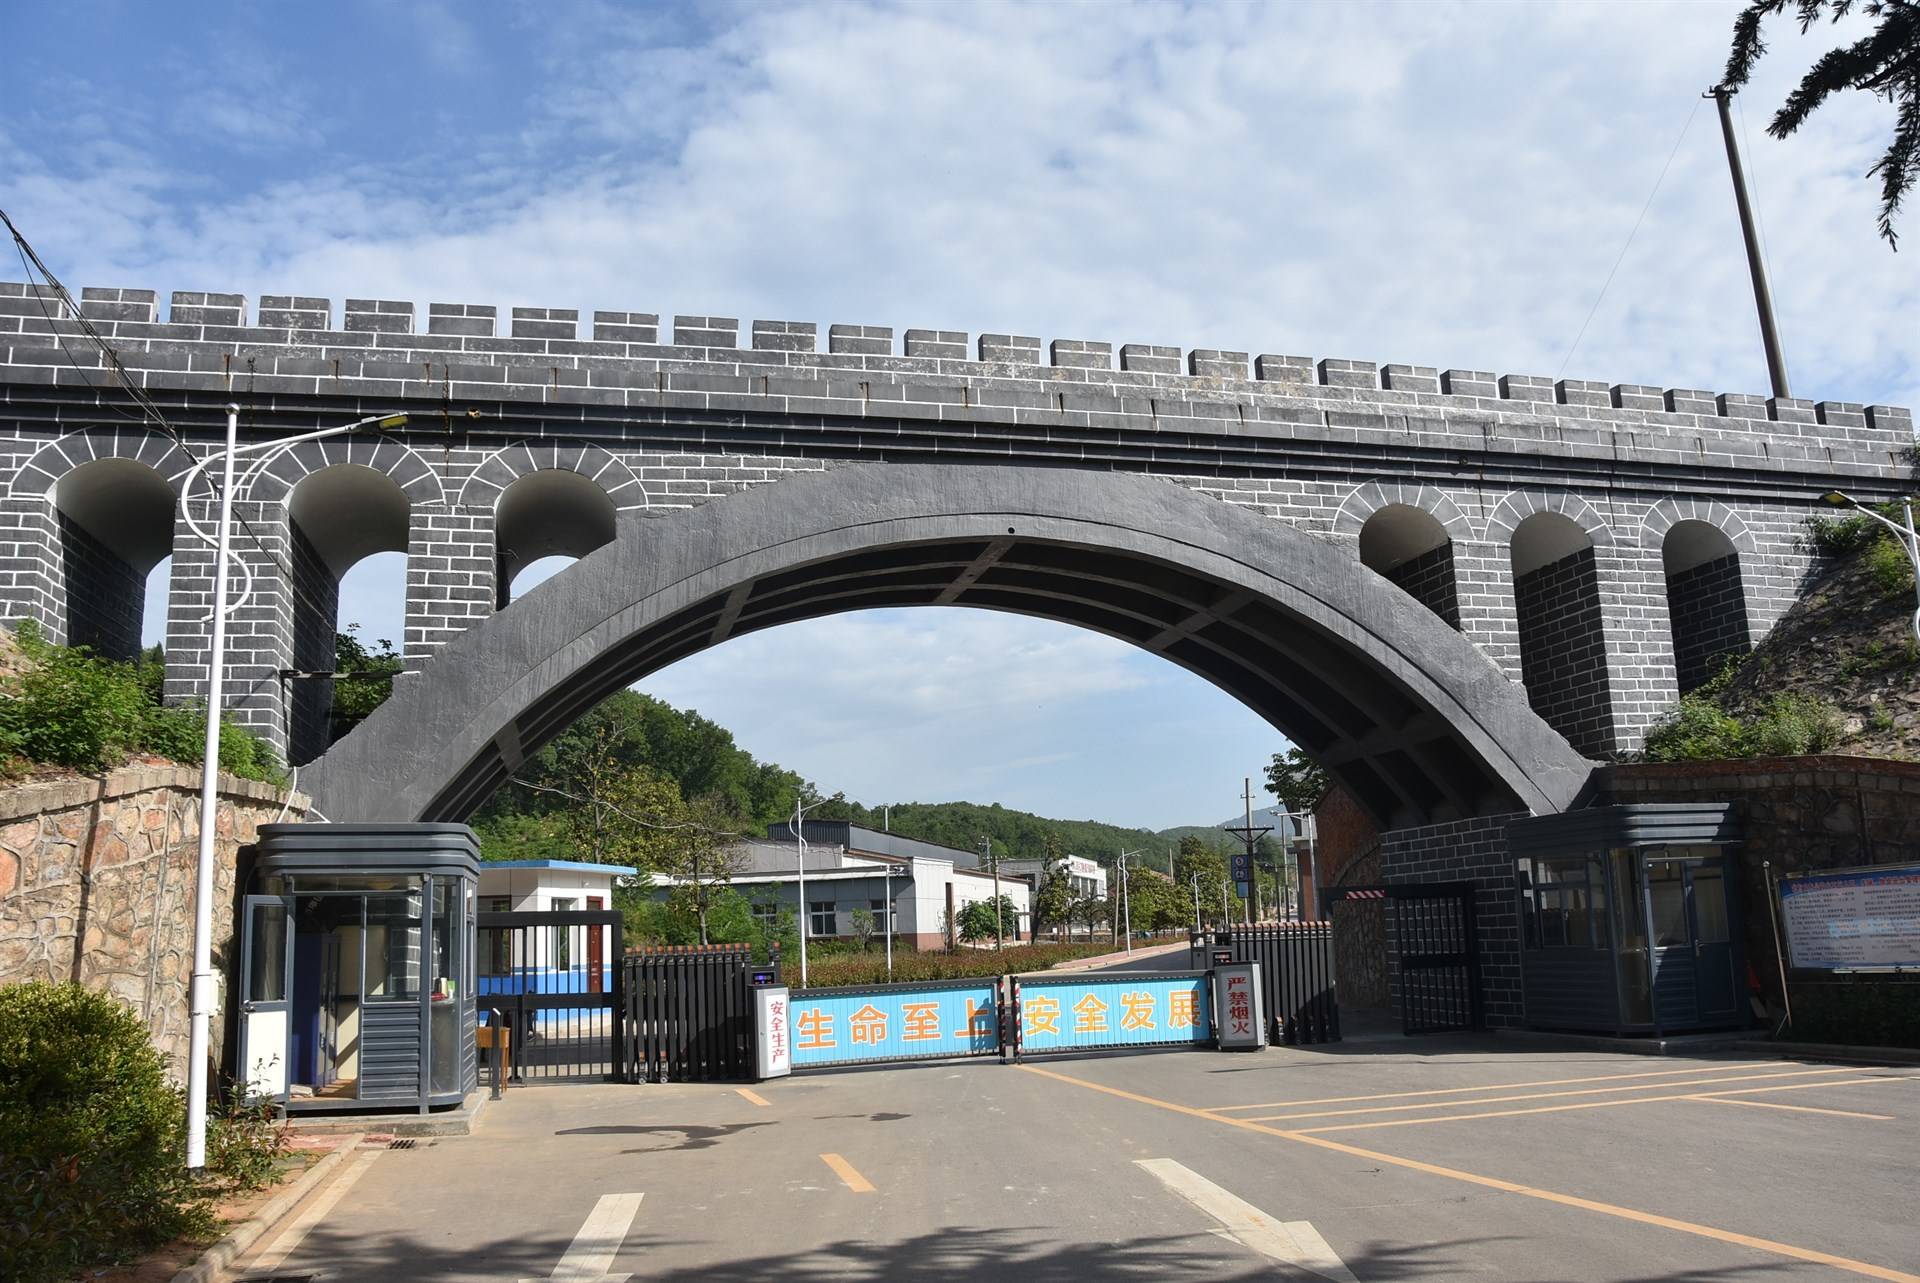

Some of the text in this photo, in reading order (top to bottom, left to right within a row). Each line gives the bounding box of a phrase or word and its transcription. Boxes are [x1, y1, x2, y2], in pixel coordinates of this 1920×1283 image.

[770, 1000, 785, 1064] 安全生产
[797, 998, 993, 1049] 生命至上
[1023, 990, 1201, 1035] 安全发展
[1228, 976, 1250, 1035] 严禁烟火
